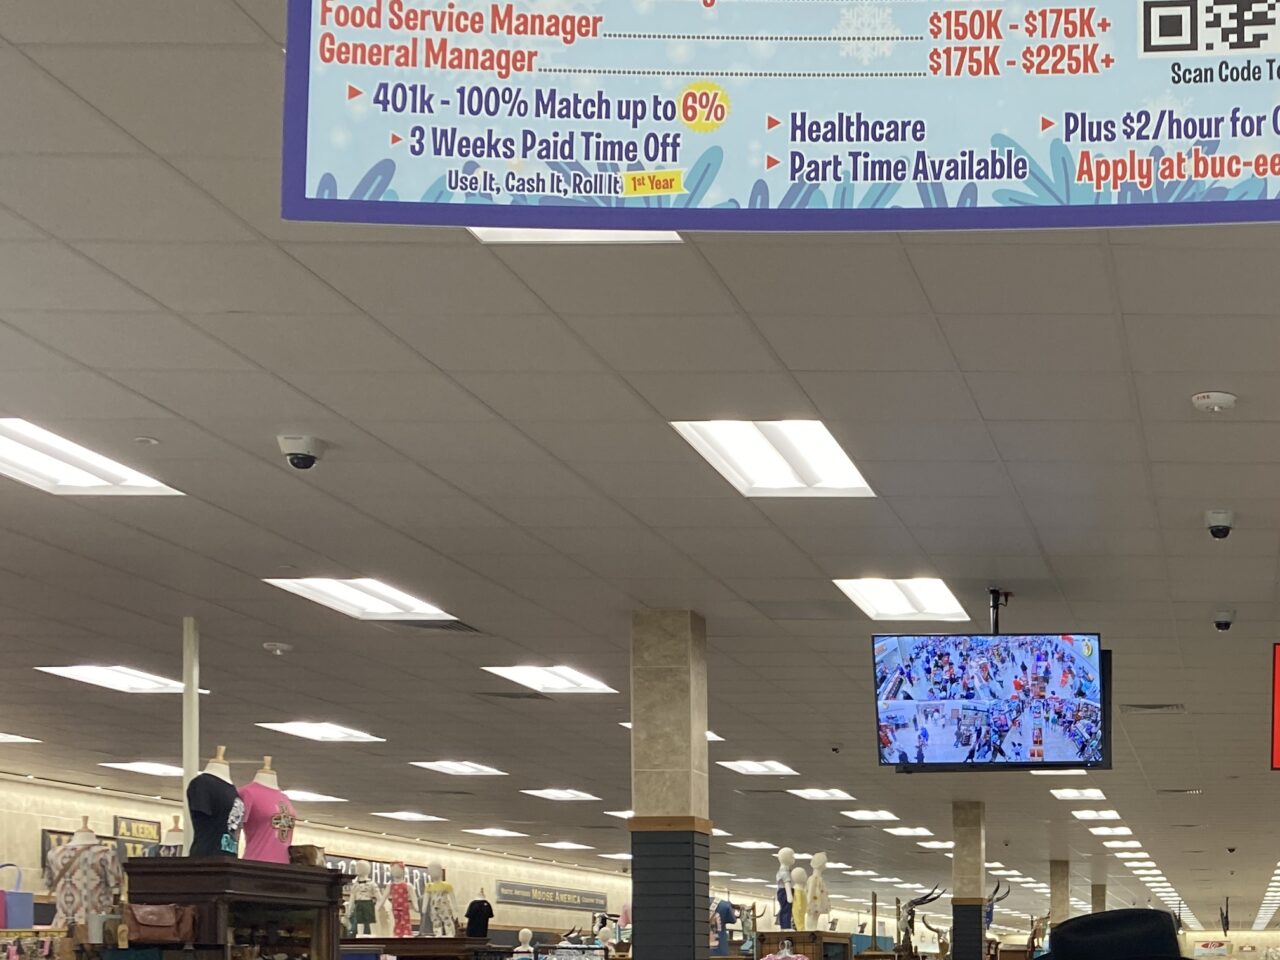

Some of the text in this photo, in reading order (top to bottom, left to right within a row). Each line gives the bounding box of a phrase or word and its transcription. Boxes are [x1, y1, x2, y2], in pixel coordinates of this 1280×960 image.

[320, 0, 603, 44] Food Service Manager
[928, 9, 1002, 41] $150K
[1024, 8, 1112, 39] $175K+
[319, 32, 538, 79] General Manager
[928, 45, 1000, 77] $175K
[1021, 43, 1115, 75] $225K+
[1171, 62, 1214, 84] Scan
[1218, 59, 1262, 83] Code
[373, 83, 434, 113] 401k
[456, 86, 528, 116] 100%
[535, 89, 611, 120] Match
[617, 97, 647, 128] up
[653, 95, 676, 120] to
[682, 92, 725, 123] 6%
[790, 112, 925, 142] Healthcare
[1064, 112, 1117, 142] Plus
[1122, 109, 1225, 141] $2/hour
[1230, 107, 1266, 138] for
[410, 126, 680, 162] 3 Weeks Paid Time Off
[790, 149, 1028, 181] Part Time Available
[1076, 150, 1152, 190] Apply
[1160, 151, 1186, 180] at
[448, 170, 478, 191] Use
[483, 171, 500, 194] It,
[505, 171, 546, 193] Cash
[550, 173, 569, 195] It,
[572, 173, 603, 194] Roll
[631, 176, 675, 190] 1st Year
